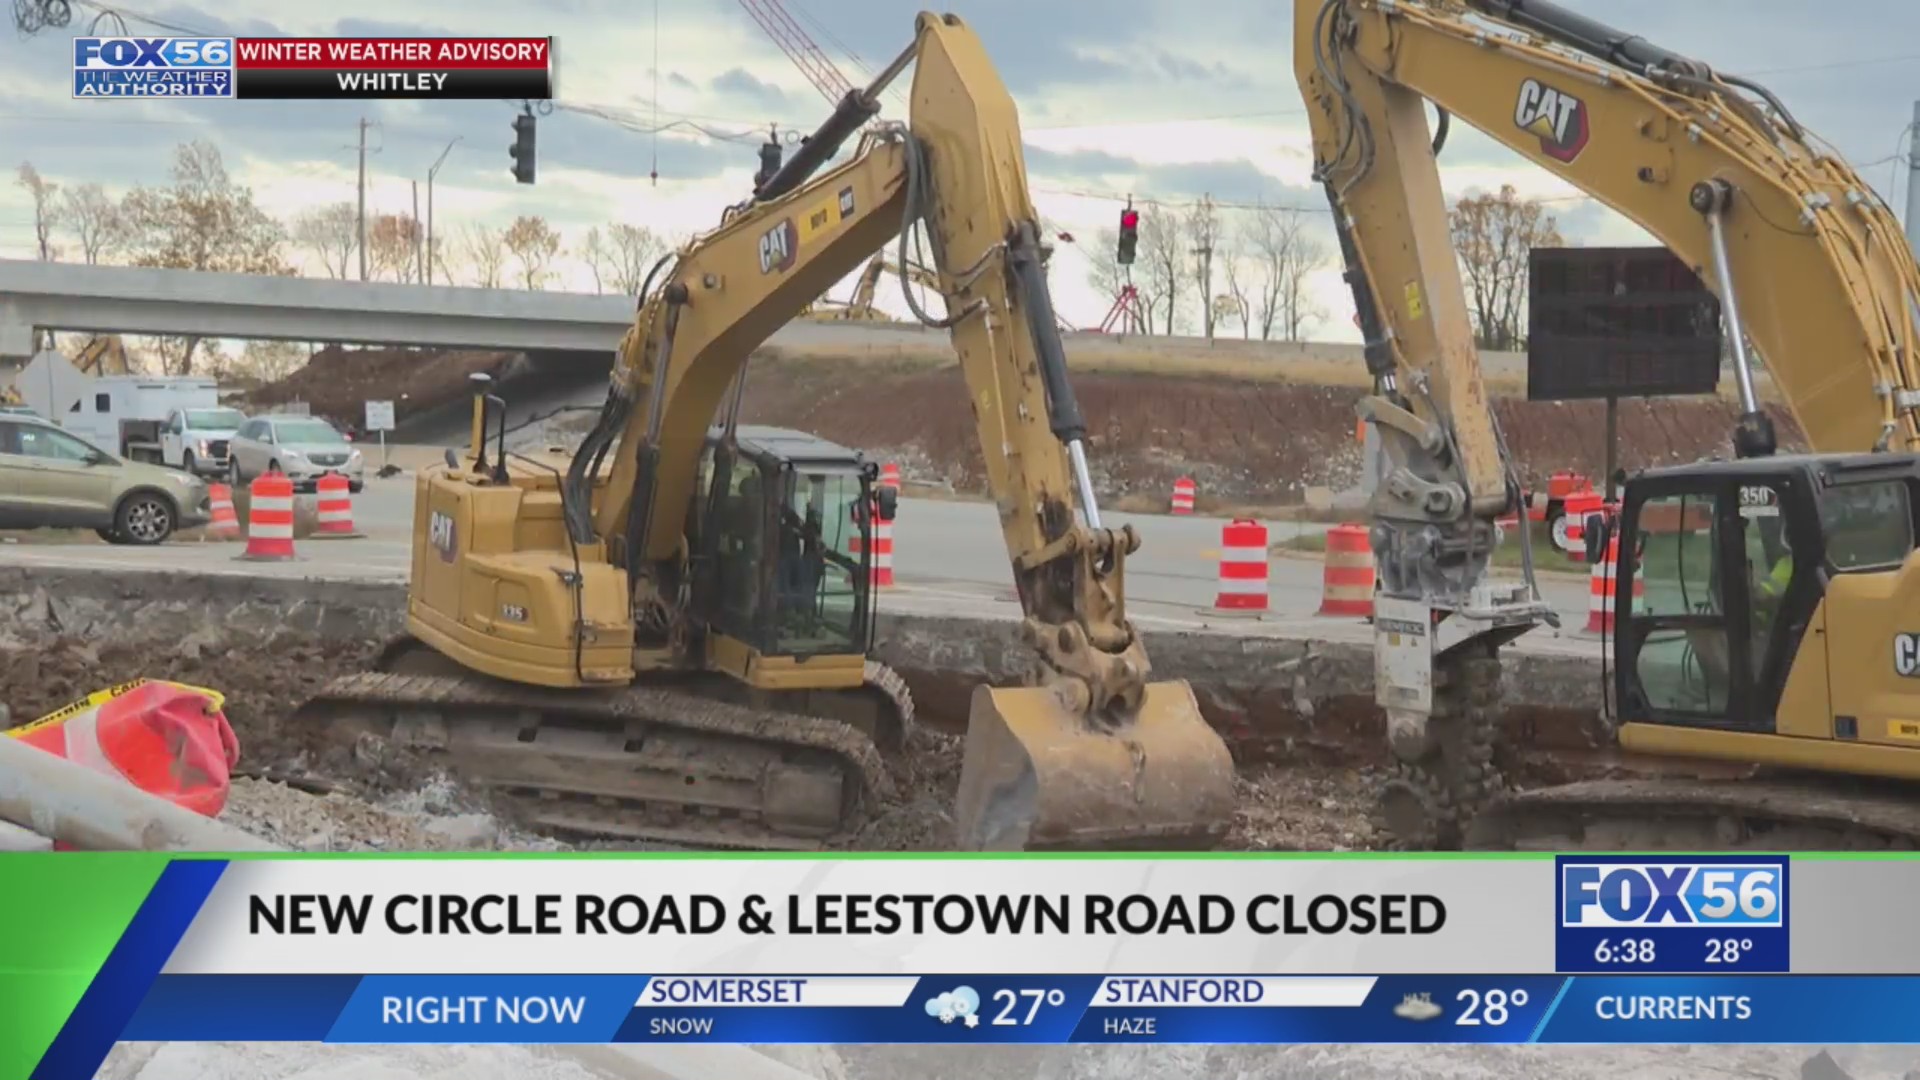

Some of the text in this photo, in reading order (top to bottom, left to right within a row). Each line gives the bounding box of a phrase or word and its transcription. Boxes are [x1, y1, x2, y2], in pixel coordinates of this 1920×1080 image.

[1515, 79, 1578, 144] CAT
[760, 221, 788, 273] CAT
[1740, 486, 1769, 505] 350
[432, 511, 453, 552] CAT
